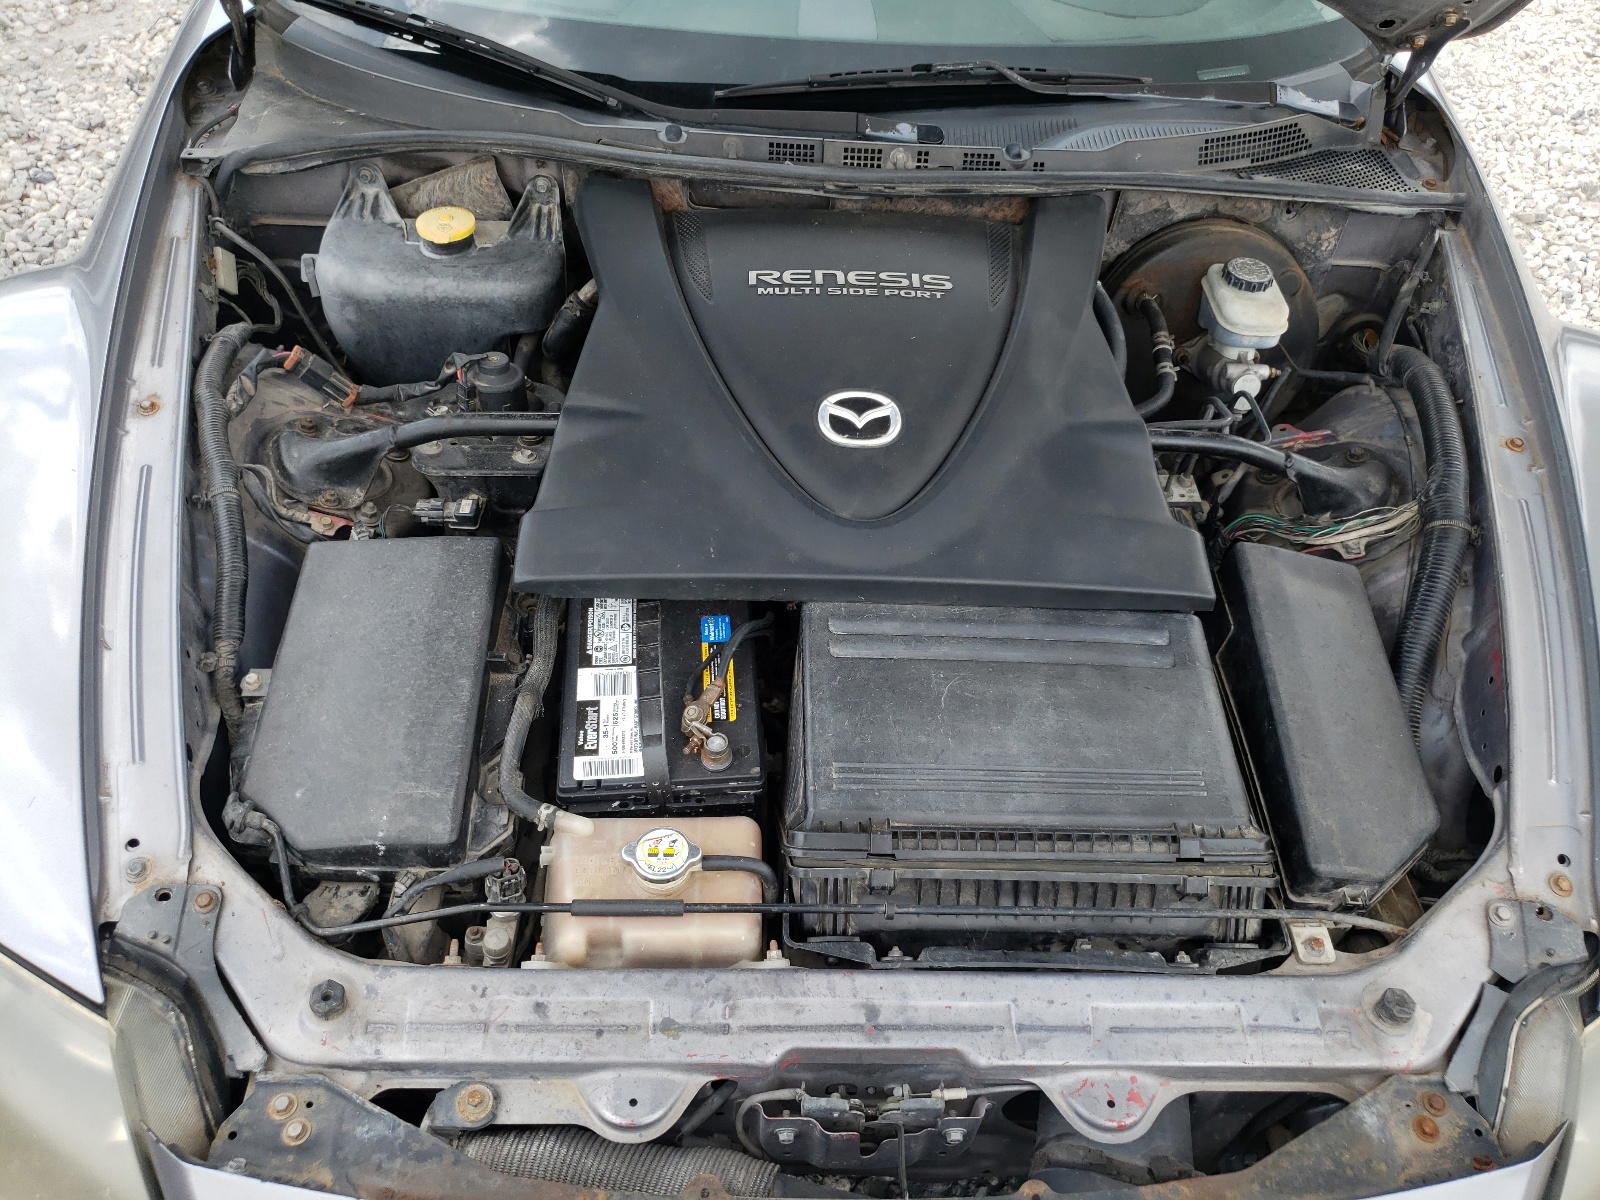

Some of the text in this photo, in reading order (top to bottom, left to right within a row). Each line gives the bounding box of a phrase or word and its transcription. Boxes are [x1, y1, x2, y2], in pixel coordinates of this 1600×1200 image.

[748, 269, 953, 289] RENESIS
[757, 287, 945, 299] MULTI SIDE PORT
[584, 706, 599, 750] EverStart
